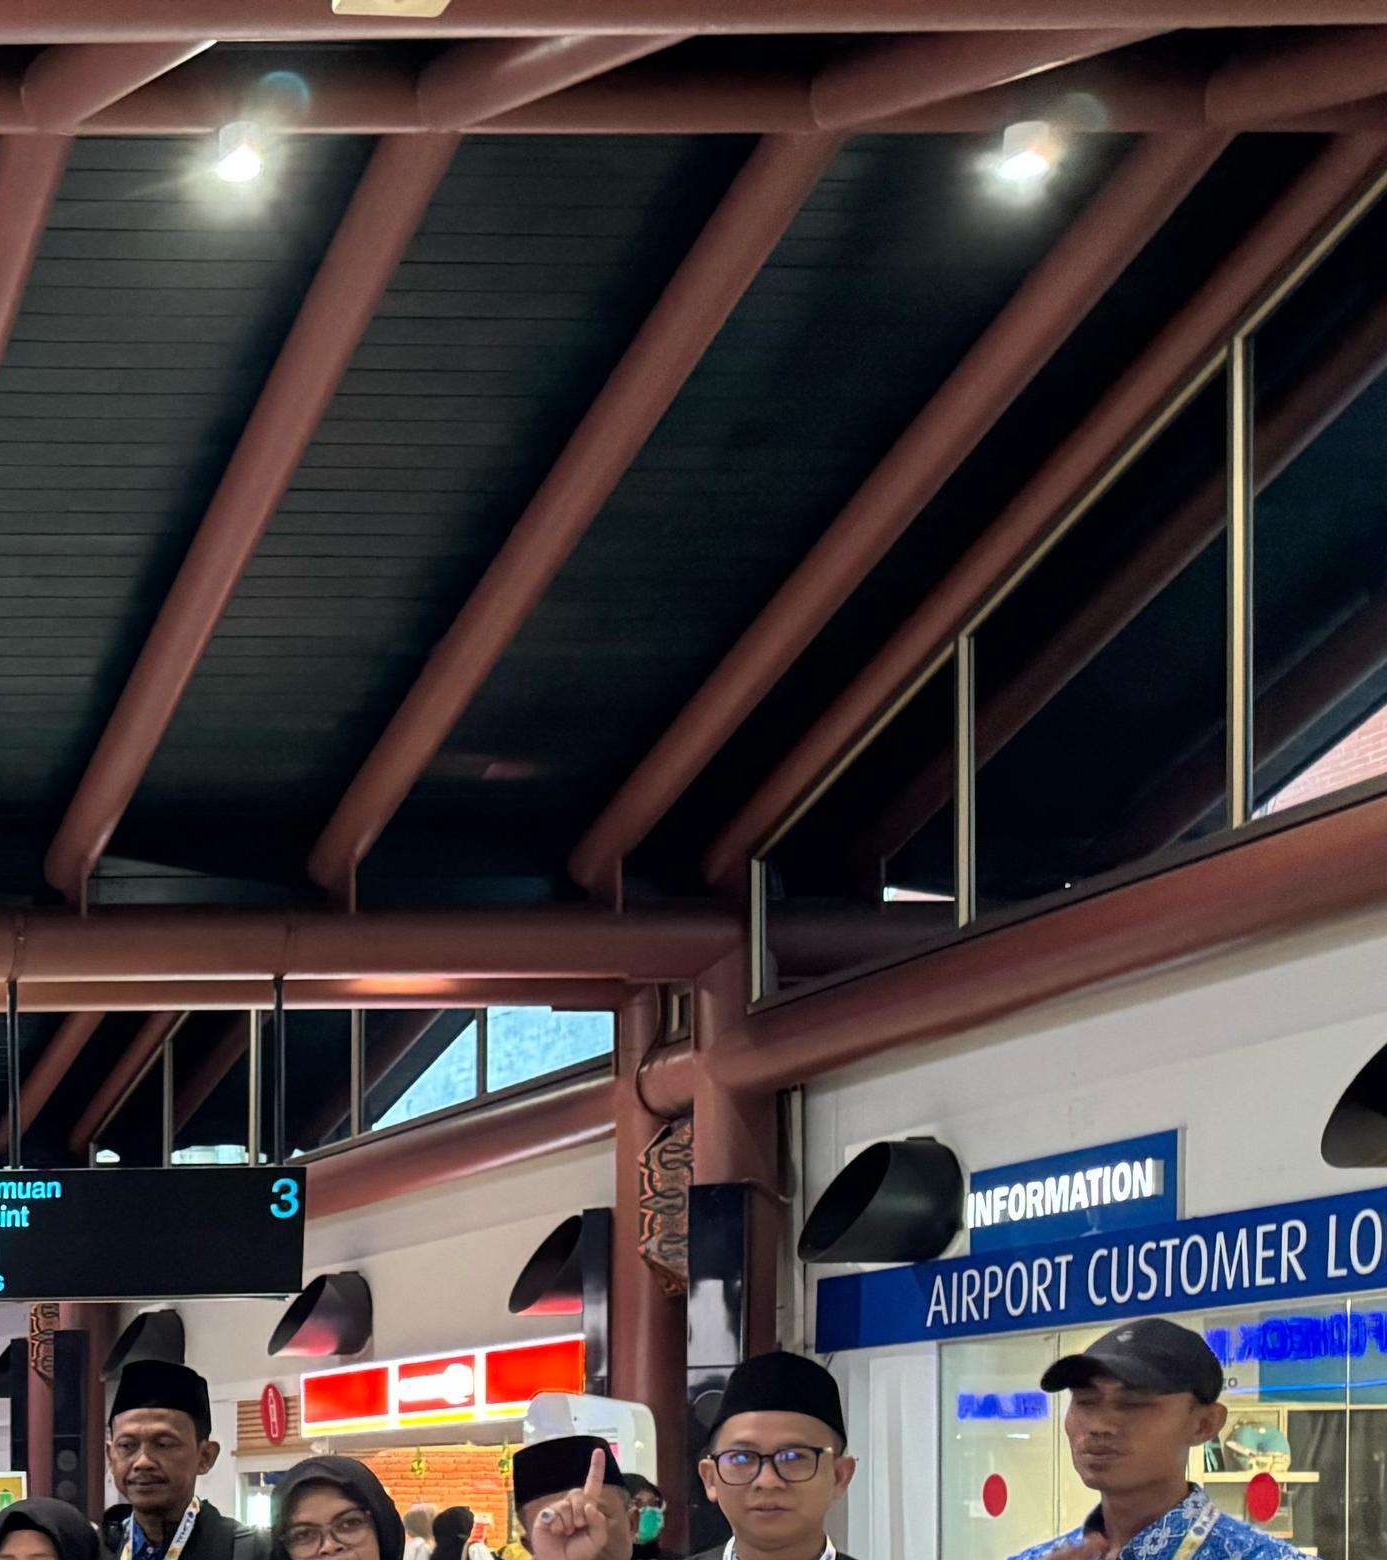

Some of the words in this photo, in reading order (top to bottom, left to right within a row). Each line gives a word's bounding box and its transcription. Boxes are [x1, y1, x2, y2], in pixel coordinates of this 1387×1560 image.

[269, 1178, 300, 1218] 3
[967, 1158, 1155, 1228] INFORMATION
[926, 1254, 1073, 1328] AIRPORT
[1087, 1219, 1308, 1306] CUSTOMER
